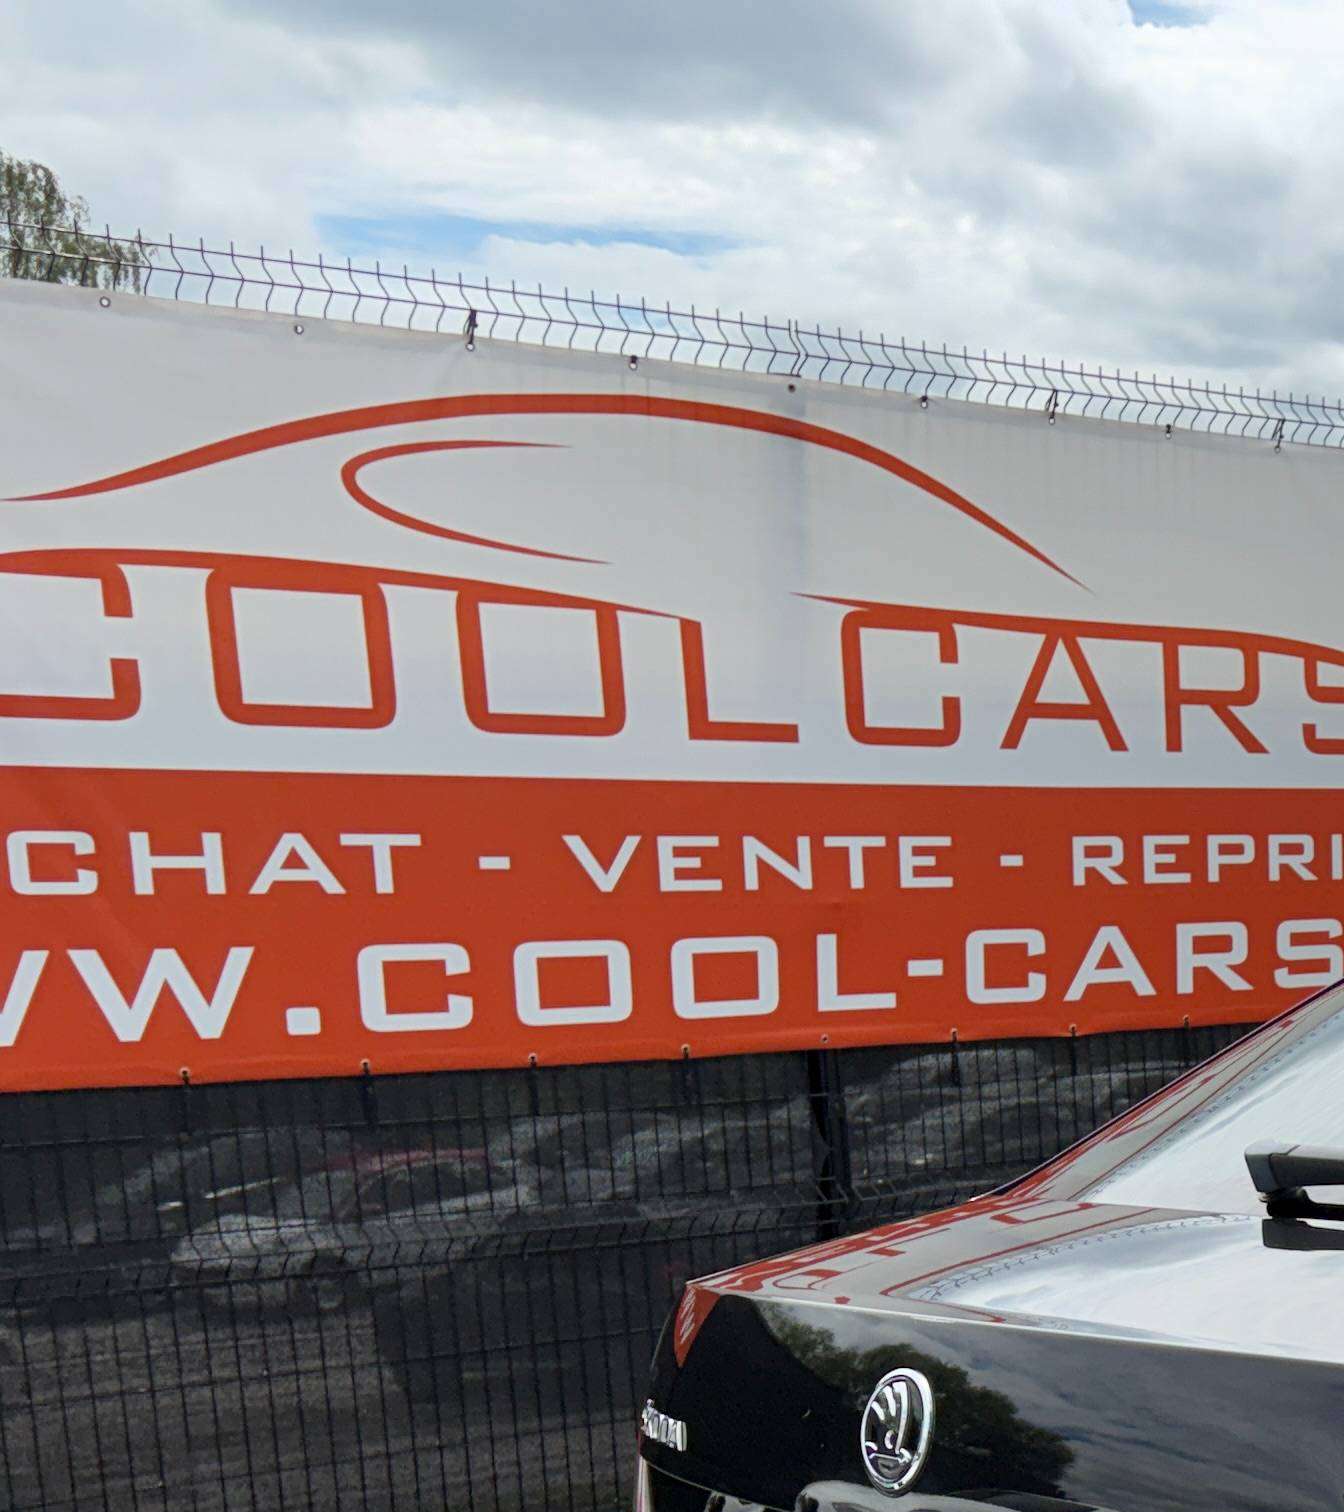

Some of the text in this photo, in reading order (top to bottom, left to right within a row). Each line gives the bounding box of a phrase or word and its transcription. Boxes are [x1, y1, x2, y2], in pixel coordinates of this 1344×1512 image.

[0, 548, 799, 743] COOL
[5, 830, 421, 896] CHAT
[562, 834, 954, 893] VENTE
